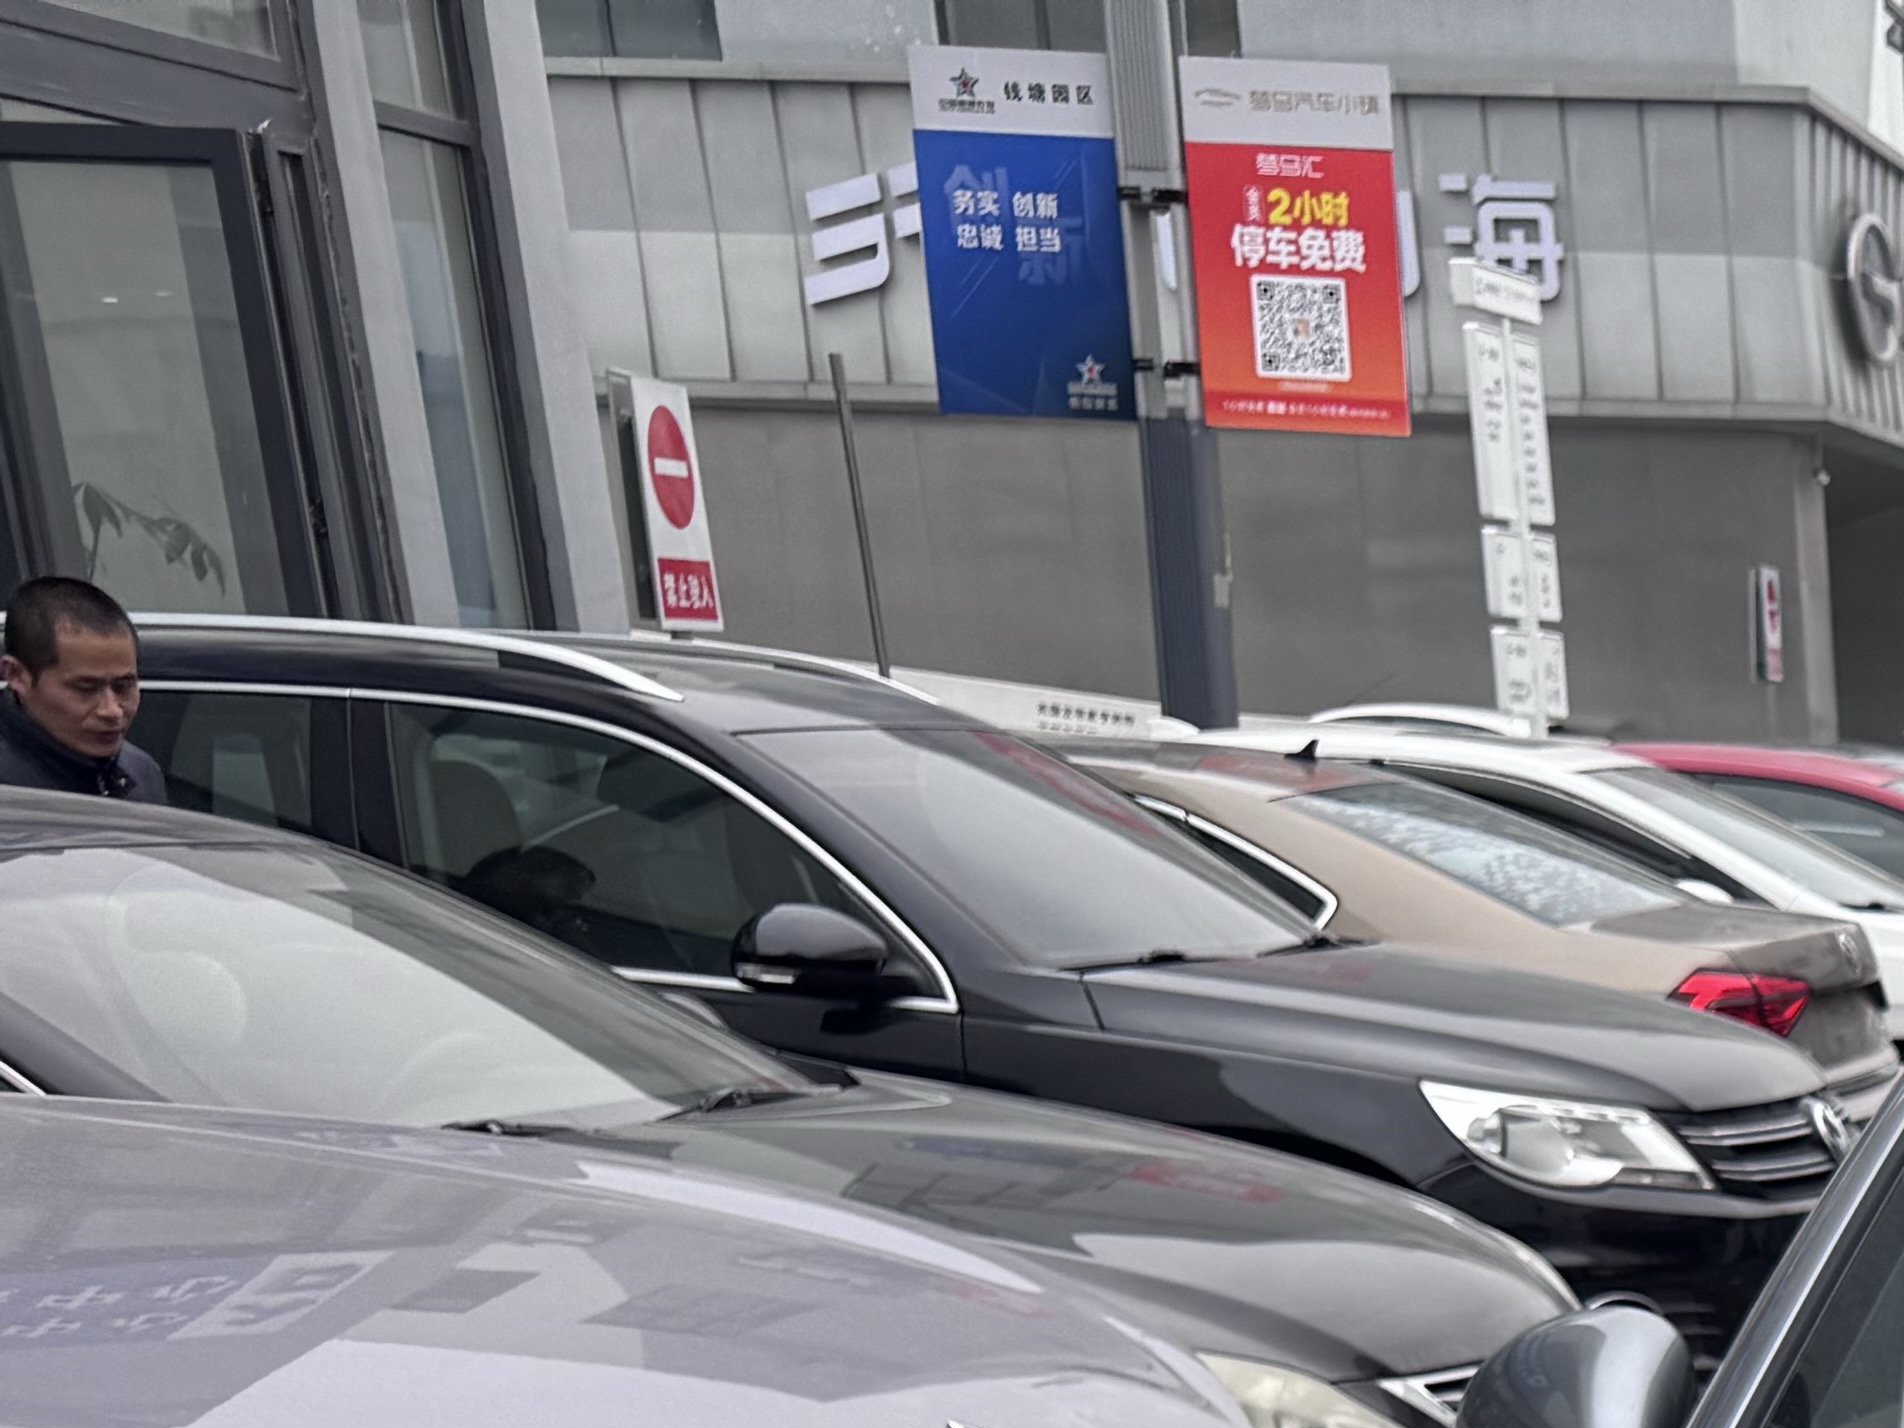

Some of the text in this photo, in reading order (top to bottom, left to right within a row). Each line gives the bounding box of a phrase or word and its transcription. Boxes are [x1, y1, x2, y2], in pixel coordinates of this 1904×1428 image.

[953, 189, 1058, 218] 务实 创新
[1267, 188, 1349, 227] 2小时
[957, 224, 1062, 252] 忠诚 担当
[1231, 223, 1366, 273] 停车免费
